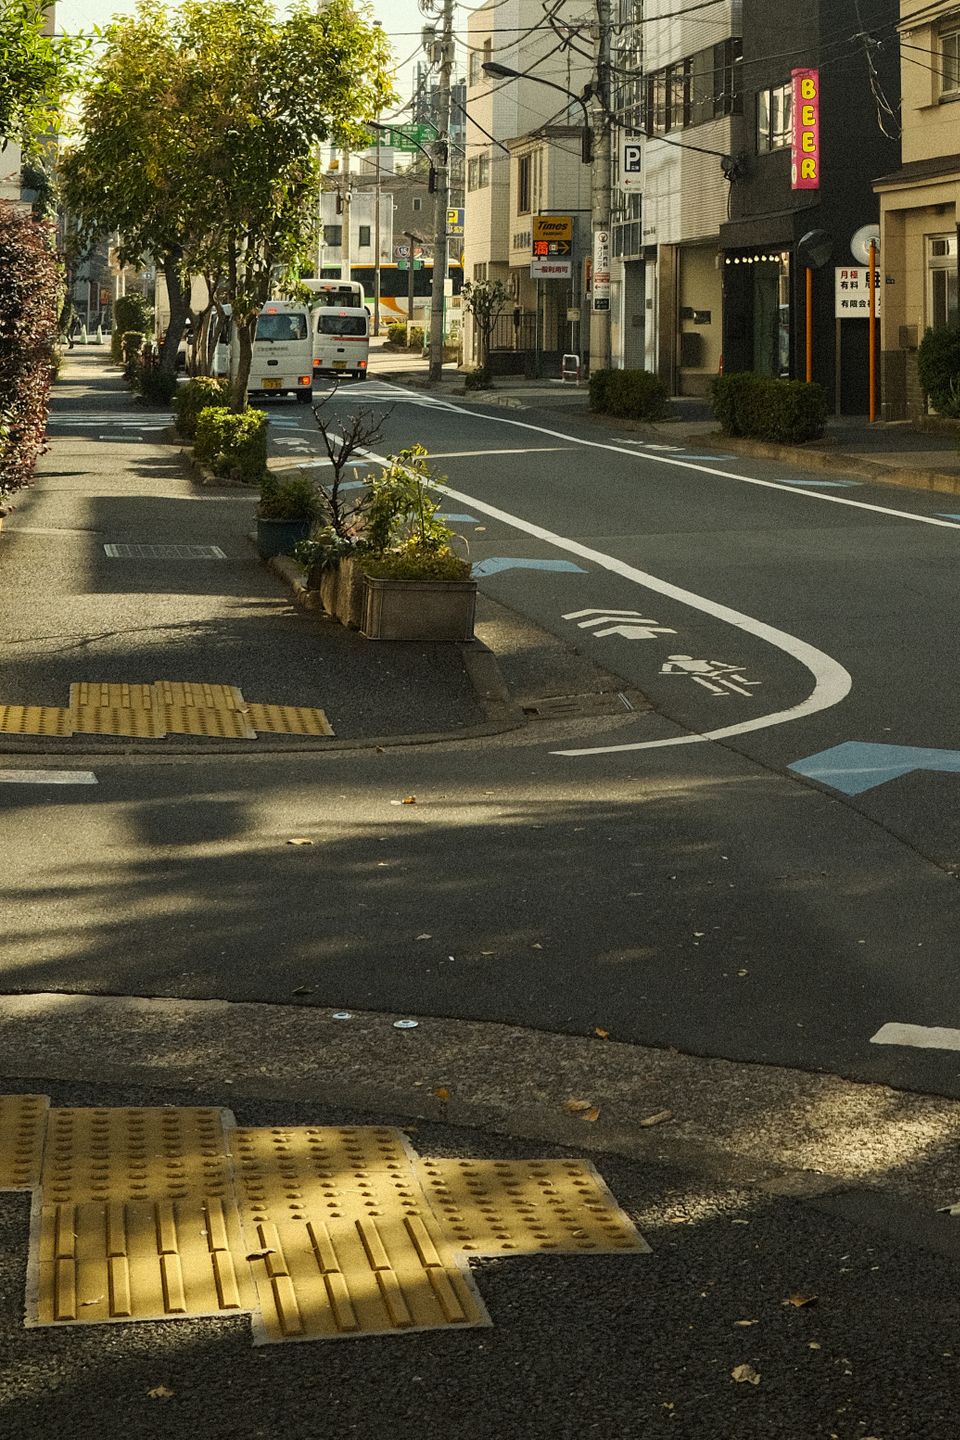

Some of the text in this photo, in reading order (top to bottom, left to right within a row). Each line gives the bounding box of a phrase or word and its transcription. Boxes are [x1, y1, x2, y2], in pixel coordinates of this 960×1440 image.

[801, 78, 817, 179] BEER
[626, 147, 640, 171] P
[538, 221, 568, 231] Times
[840, 270, 859, 279] 月極
[840, 280, 859, 289] 有料
